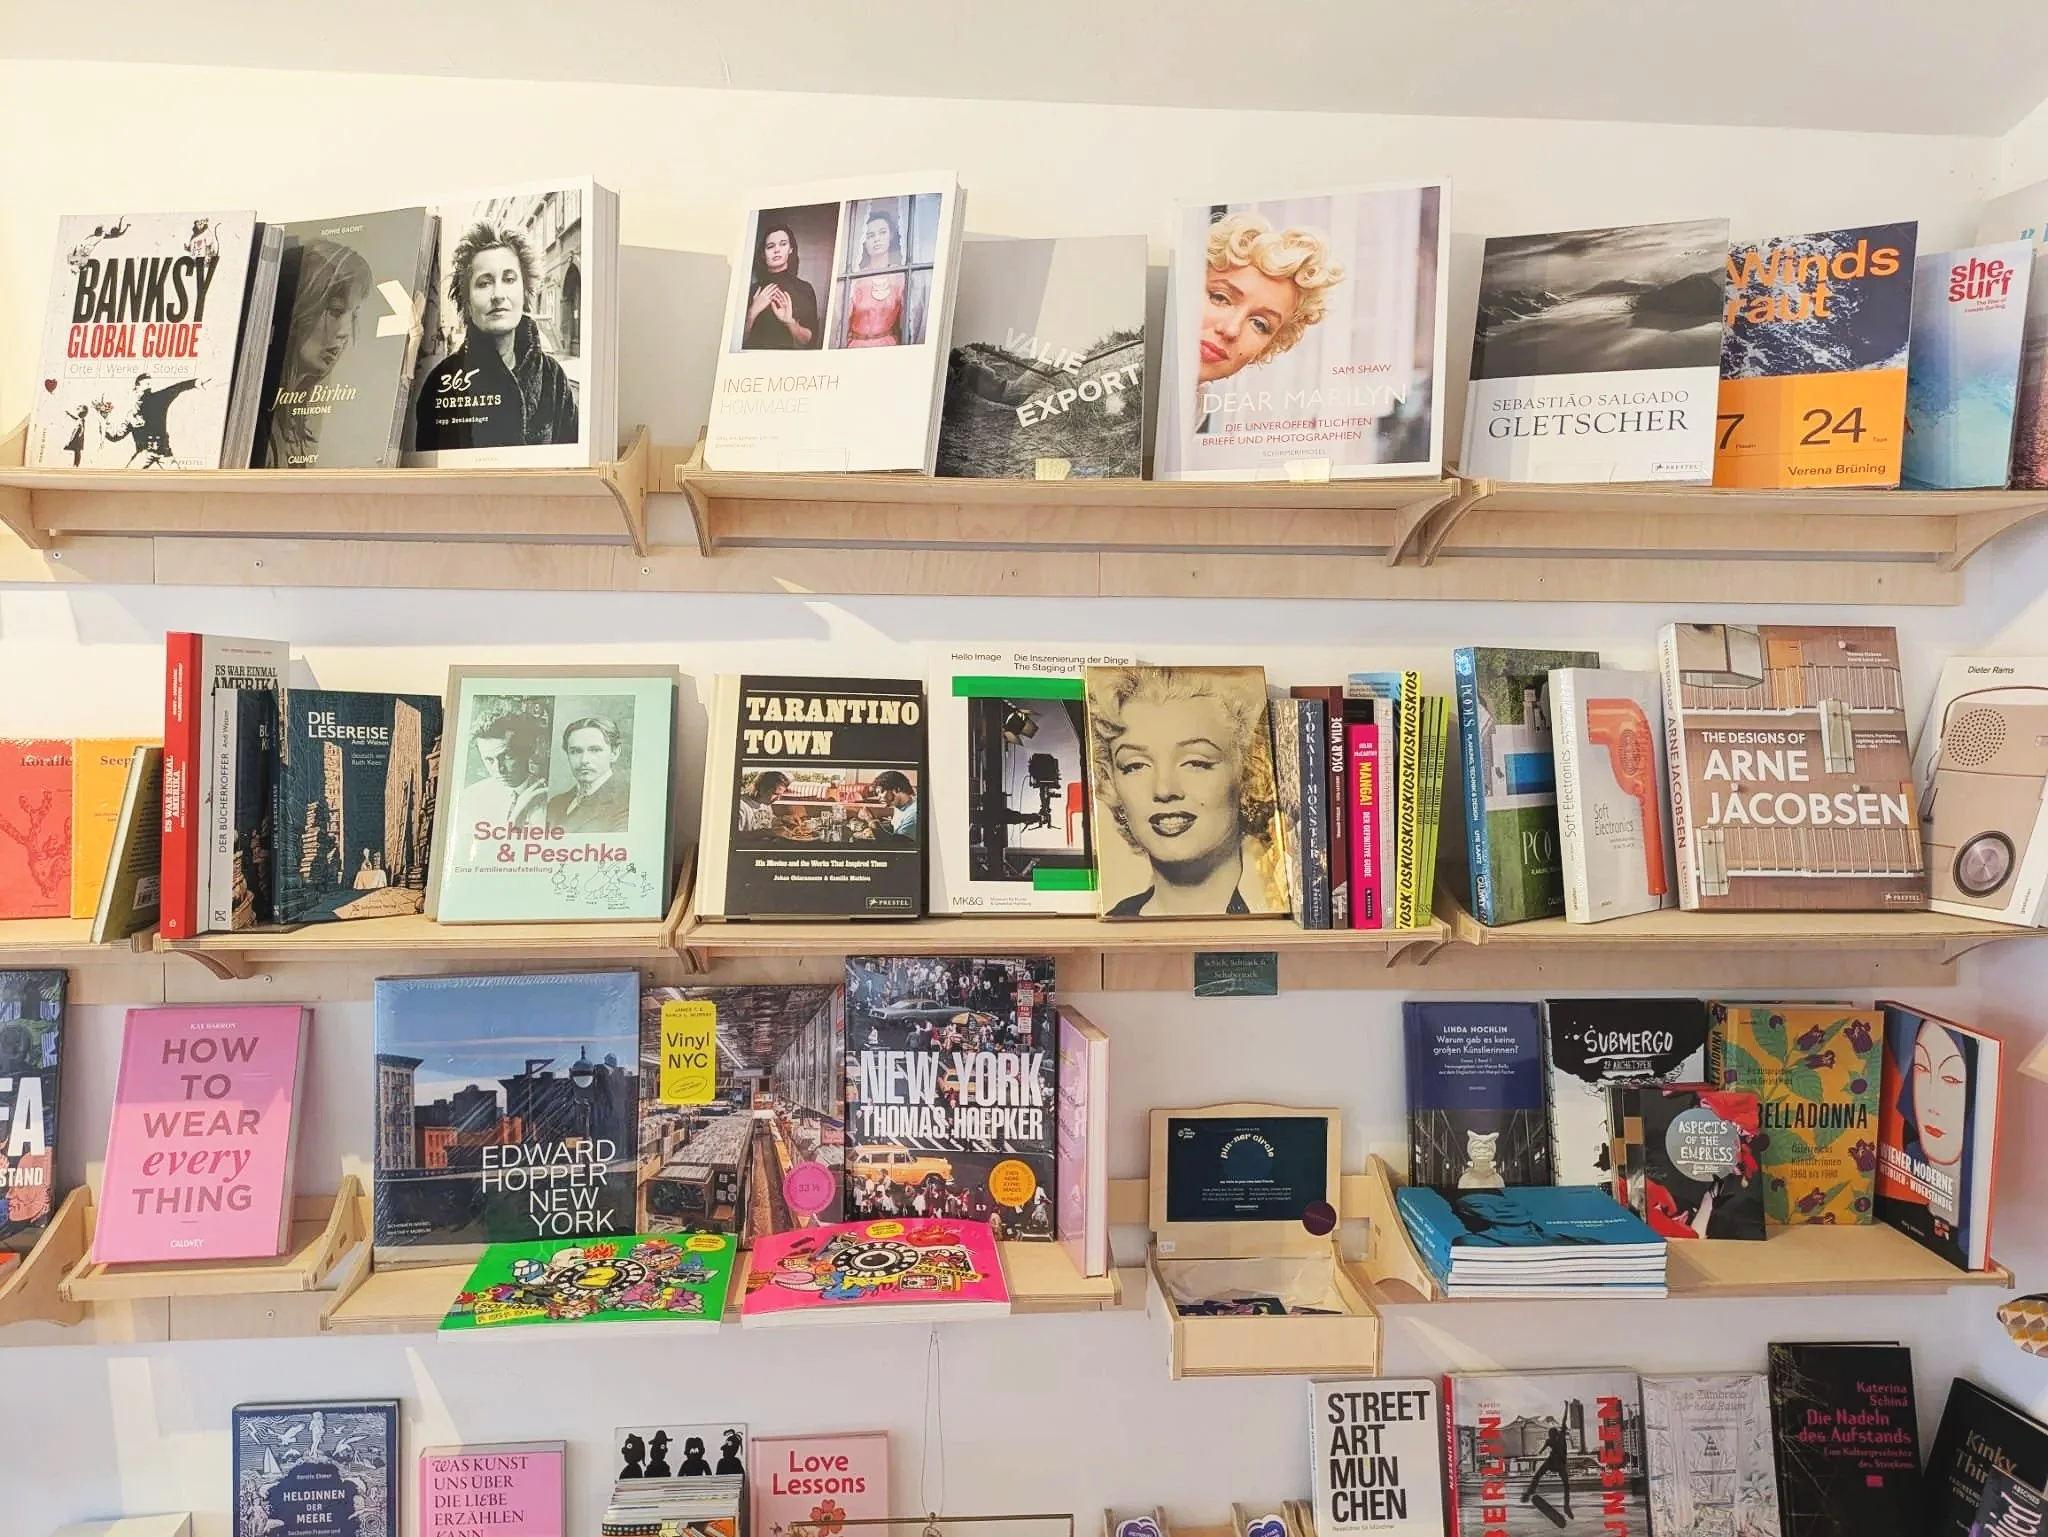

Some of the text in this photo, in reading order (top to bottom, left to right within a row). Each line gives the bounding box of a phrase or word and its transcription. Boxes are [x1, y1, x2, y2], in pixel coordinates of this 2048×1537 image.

[1727, 239, 1901, 289] Winds
[1950, 257, 2004, 284] she
[72, 255, 220, 323] BANKSY
[1948, 269, 2014, 303] surf
[67, 323, 203, 358] GLOBAL GUIDE
[1005, 327, 1087, 376] VALIE
[70, 363, 93, 374] Orte
[438, 368, 480, 393] 365
[1332, 363, 1392, 375] SAM SHAW
[723, 375, 840, 393] INGE MORATH
[1016, 363, 1140, 428] EXPORT
[270, 384, 357, 411] Jane Birkin
[435, 394, 502, 409] PORTRAITS
[720, 397, 809, 415] HOMMAGE
[1202, 383, 1407, 414] DEAR MARILYN
[1492, 390, 1689, 412] SEBASTIÃO SALGADO
[1225, 422, 1244, 433] DIE
[1488, 409, 1689, 439] GLETSCHER
[1717, 407, 1867, 450] 7 24
[1202, 431, 1362, 447] BRIEFE UND PHOTOGRAPHIEN
[1787, 463, 1886, 477] Verena Brüning
[951, 653, 1002, 663] Hello Image
[1013, 653, 1129, 666] Die Inszenierung der Dinge
[1013, 663, 1077, 674] The Staging of
[1967, 666, 2015, 674] Dieter Rams
[215, 665, 278, 677] ES WAR EINMAL
[746, 697, 920, 725] TARANTINO
[1460, 683, 1474, 728] POOLS
[308, 711, 336, 725] DIE
[308, 725, 389, 740] LESEREISE
[743, 729, 833, 755] TOWN
[1331, 717, 1343, 745] WILDE
[1667, 717, 1680, 760] ARNE
[1702, 732, 1806, 745] THE DESIGNS OF
[1331, 746, 1343, 773] OSCAR
[1704, 750, 1810, 781] ARNE
[164, 755, 174, 832] ES WAR EINMAL
[172, 770, 181, 817] AMERIKA
[1359, 762, 1373, 806] MANGA!
[1562, 749, 1577, 837] Soft Electronics
[218, 753, 230, 853] DER BÜCHERKOFFER
[1593, 802, 1610, 819] Soft
[1671, 765, 1687, 849] JACOBSEN
[1707, 792, 1910, 825] JACOBSEN
[1363, 811, 1371, 823] DER
[1594, 813, 1635, 836] Electronics
[474, 821, 565, 841] Schiele
[497, 843, 628, 863] & Peschka
[1363, 858, 1372, 877] GUIDE
[952, 896, 984, 906] MK&G
[162, 1036, 259, 1065] HOW
[667, 1032, 710, 1049] Vinyl
[1436, 1035, 1464, 1043] Warum
[1466, 1035, 1481, 1048] gab
[1494, 1035, 1516, 1043] keine
[1584, 1029, 1673, 1053] SUBMERGO
[668, 1053, 708, 1069] NYC
[180, 1073, 231, 1100] TO
[860, 1050, 1044, 1107] NEW YORK
[143, 1109, 260, 1138] WEAR
[861, 1105, 1044, 1141] THOMAS HOEPKER
[1678, 1121, 1728, 1135] ASPECTS
[1220, 1133, 1251, 1159] pin-ner
[1252, 1134, 1275, 1158] circle
[1685, 1135, 1720, 1146] OF THE
[142, 1147, 251, 1183] every
[482, 1139, 616, 1170] EDWARD
[1680, 1146, 1733, 1162] EMPRESS
[482, 1162, 608, 1194] HOPPER
[1879, 1143, 1953, 1196] WIENER MODERNE
[132, 1184, 252, 1215] THING
[529, 1187, 599, 1214] NEW
[529, 1208, 615, 1237] YORK
[1856, 1381, 1908, 1394] Katerina
[1328, 1390, 1430, 1424] STREET
[1807, 1408, 1890, 1426] Die Nadeln
[1330, 1424, 1386, 1456] ART
[1799, 1426, 1912, 1444] des Aufstands
[789, 1450, 849, 1473] Love
[1966, 1429, 2017, 1474] Kinky
[432, 1455, 529, 1474] WAS KUNST
[433, 1471, 515, 1491] UNS ÜBER
[772, 1473, 866, 1496] Lessons
[283, 1489, 345, 1502] HELDINNEN
[434, 1492, 509, 1509] DIE LIEBE
[1332, 1488, 1408, 1522] CHEN
[296, 1512, 333, 1524] MEERE
[306, 1504, 323, 1512] DER
[434, 1508, 525, 1527] ERZÄHLEN
